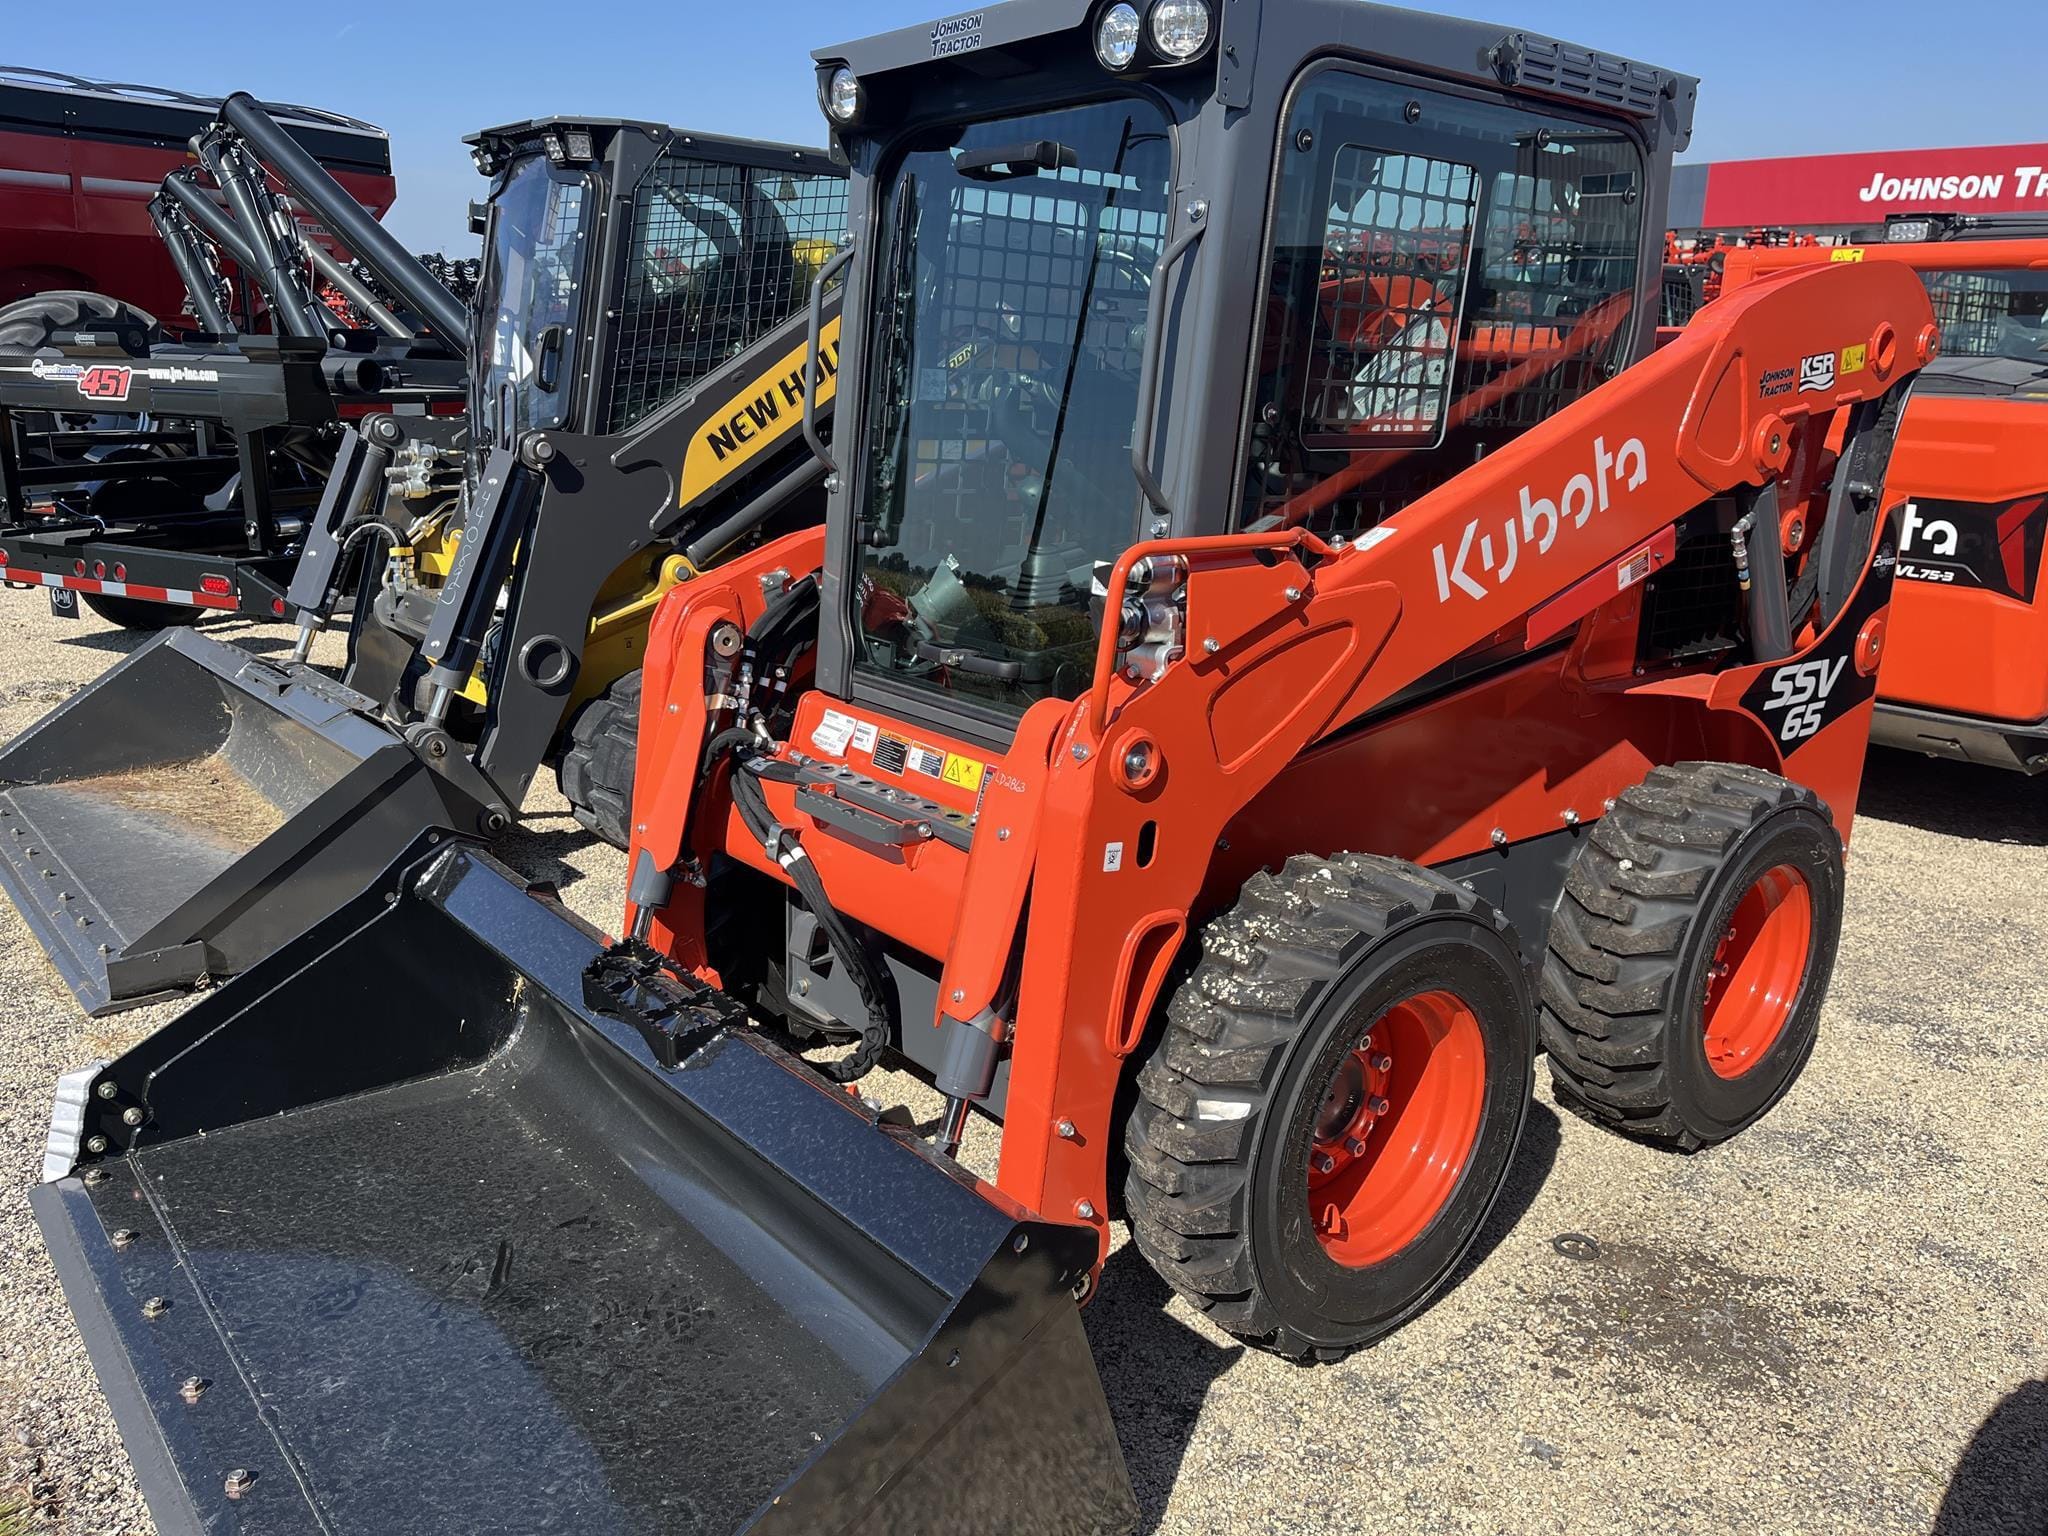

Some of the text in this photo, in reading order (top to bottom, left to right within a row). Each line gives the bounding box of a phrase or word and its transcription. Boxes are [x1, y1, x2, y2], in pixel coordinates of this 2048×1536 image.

[930, 13, 984, 39] JOHNSON
[931, 34, 982, 57] TRACTOR
[1859, 172, 2004, 202] JOHNSON
[1760, 366, 1796, 385] JOHNSON
[1800, 352, 1835, 378] KSR
[80, 367, 131, 398] 451
[1760, 381, 1793, 398] TRACTOR
[706, 388, 780, 461] NEW
[1432, 435, 1648, 604] Kubota
[1763, 655, 1849, 711] SSV
[1780, 700, 1826, 741] 65
